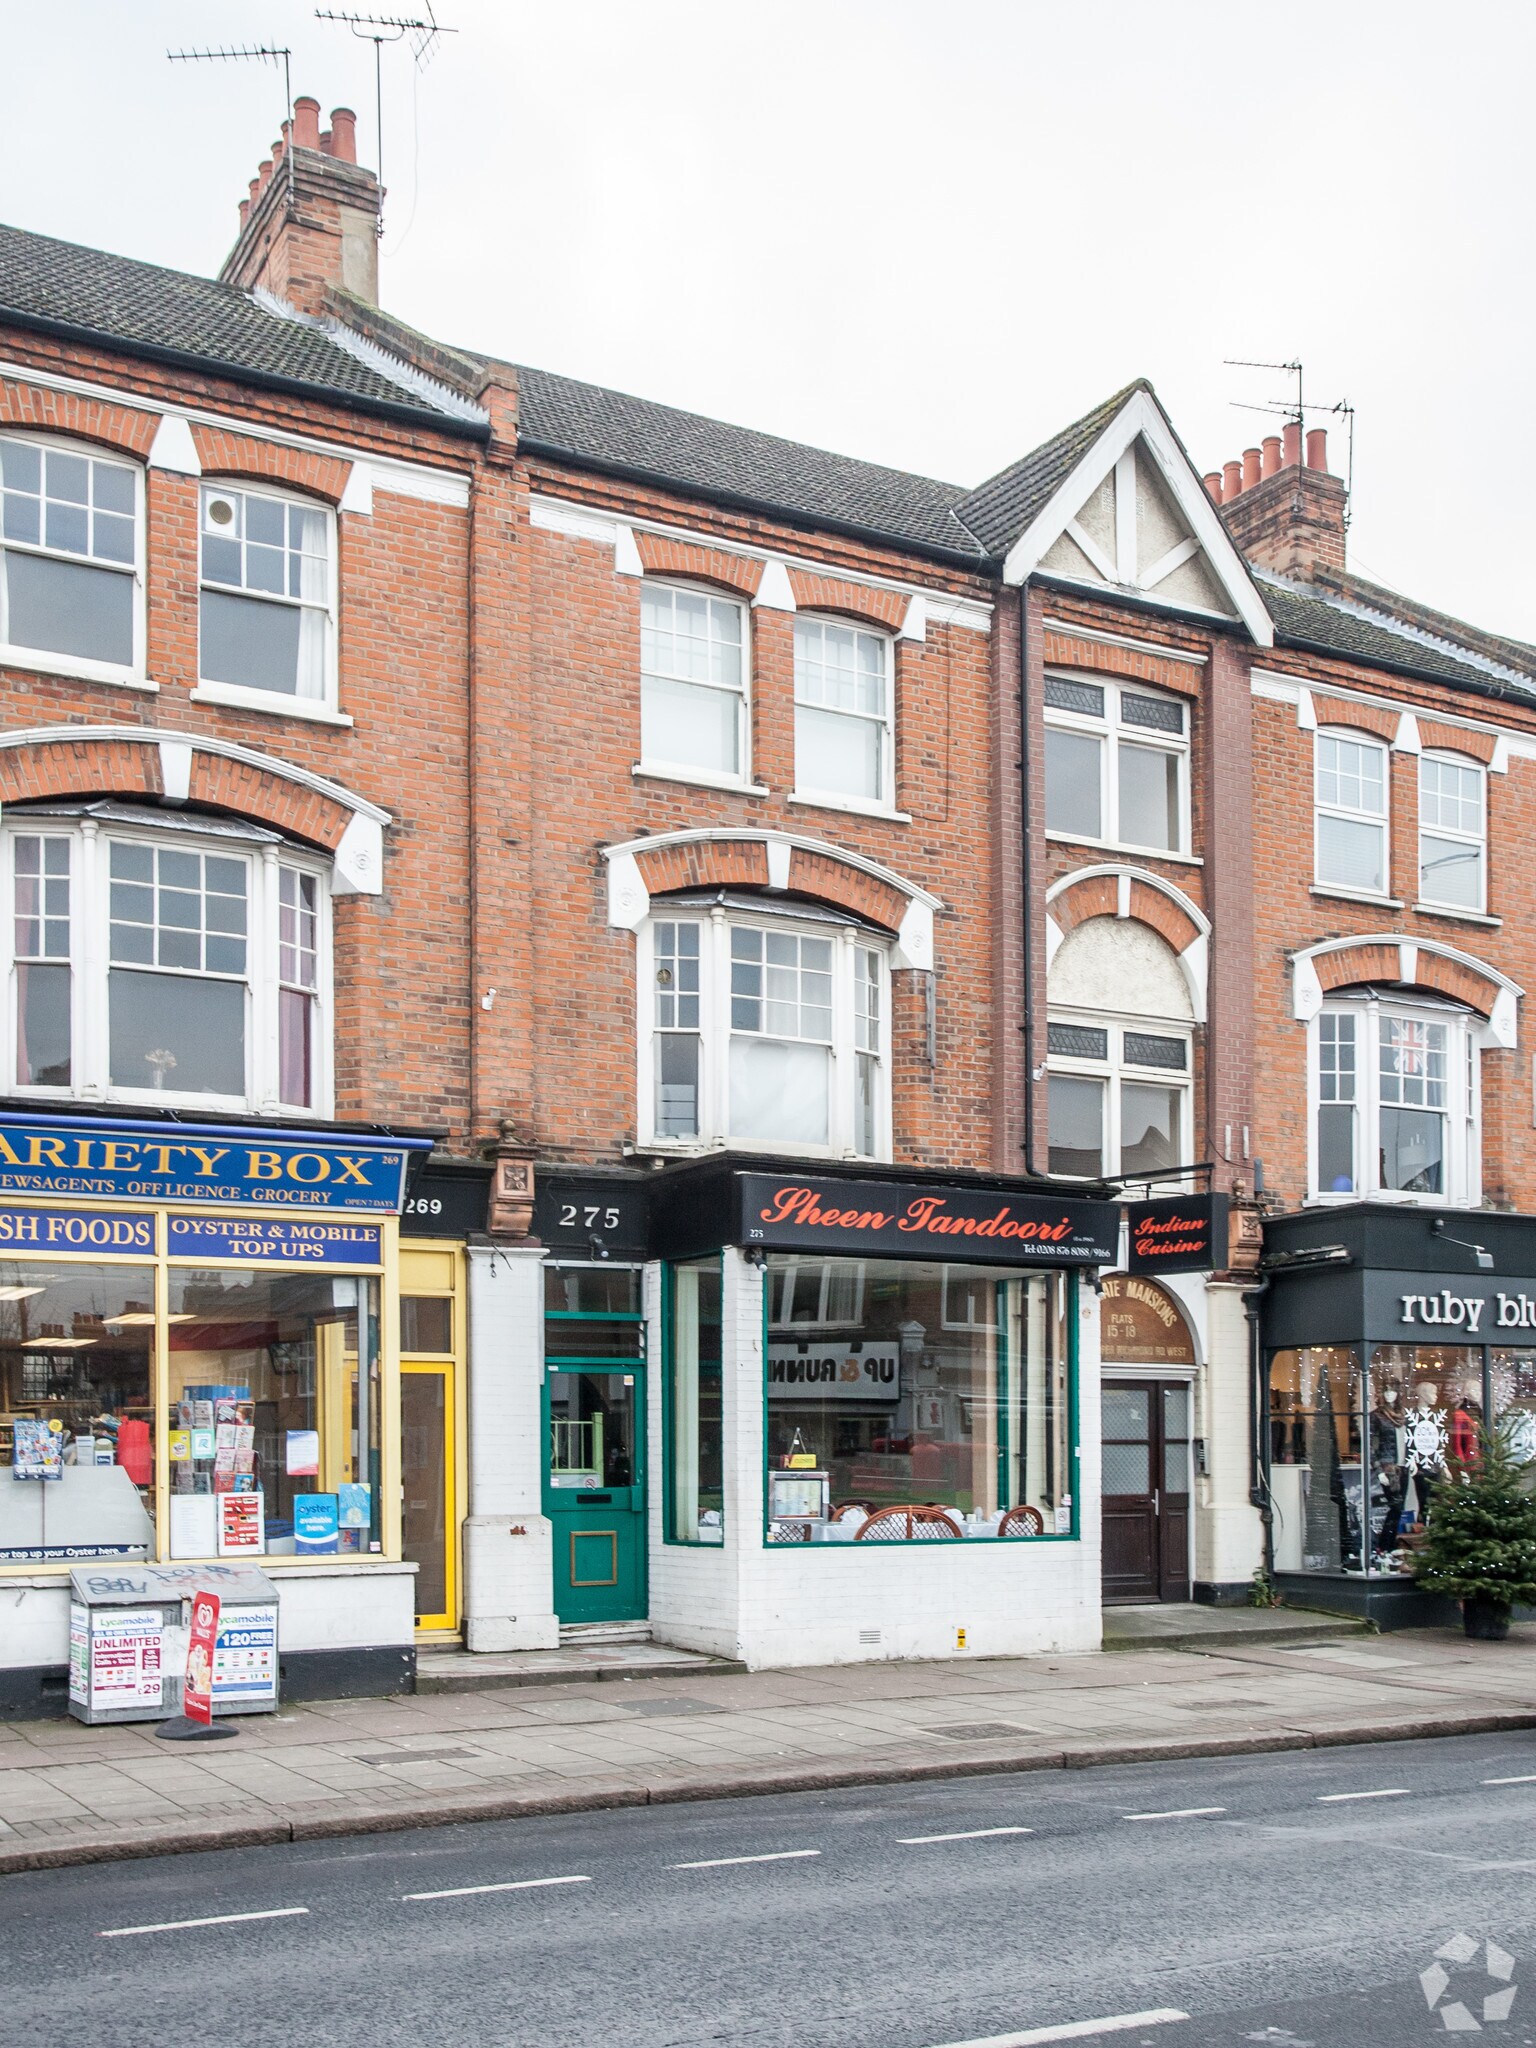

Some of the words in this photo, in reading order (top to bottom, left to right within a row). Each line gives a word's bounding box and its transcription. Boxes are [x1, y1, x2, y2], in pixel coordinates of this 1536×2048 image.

[243, 1150, 373, 1185] BOX
[382, 1155, 399, 1165] 269
[0, 1174, 115, 1193] EWSAGENTS
[127, 1181, 163, 1195] OFF
[165, 1183, 241, 1199] LICENCE
[251, 1188, 332, 1204] GROCERY
[345, 1198, 367, 1206] OPEN
[373, 1200, 394, 1208] DAYS
[405, 1198, 442, 1215] 269
[559, 1204, 621, 1230] 275
[760, 1187, 895, 1230] Sheen
[898, 1197, 1073, 1241] Tandoori
[46, 1217, 151, 1246] FOODS
[171, 1219, 263, 1237] OYSTER
[267, 1224, 285, 1238] &
[290, 1225, 377, 1242] MOBILE
[749, 1228, 764, 1238] 275
[1134, 1215, 1208, 1236] Indian
[228, 1239, 277, 1255] TOP
[280, 1242, 325, 1258] UPS
[1135, 1238, 1207, 1256] Cuisine
[1126, 1281, 1178, 1328] MANSIONS
[1401, 1290, 1485, 1332] ruby
[1111, 1313, 1134, 1324] FLATS
[1166, 1346, 1187, 1357] WEST
[297, 1503, 331, 1515] oyster
[11, 1549, 28, 1559] top
[30, 1549, 42, 1559] up
[44, 1549, 65, 1559] your
[66, 1547, 97, 1558] Oyster
[100, 1616, 155, 1627] Lycamobile
[218, 1613, 274, 1625] ycamobile
[94, 1637, 161, 1649] UNLIMITED
[222, 1632, 251, 1647] 120
[250, 1631, 273, 1641] FREE
